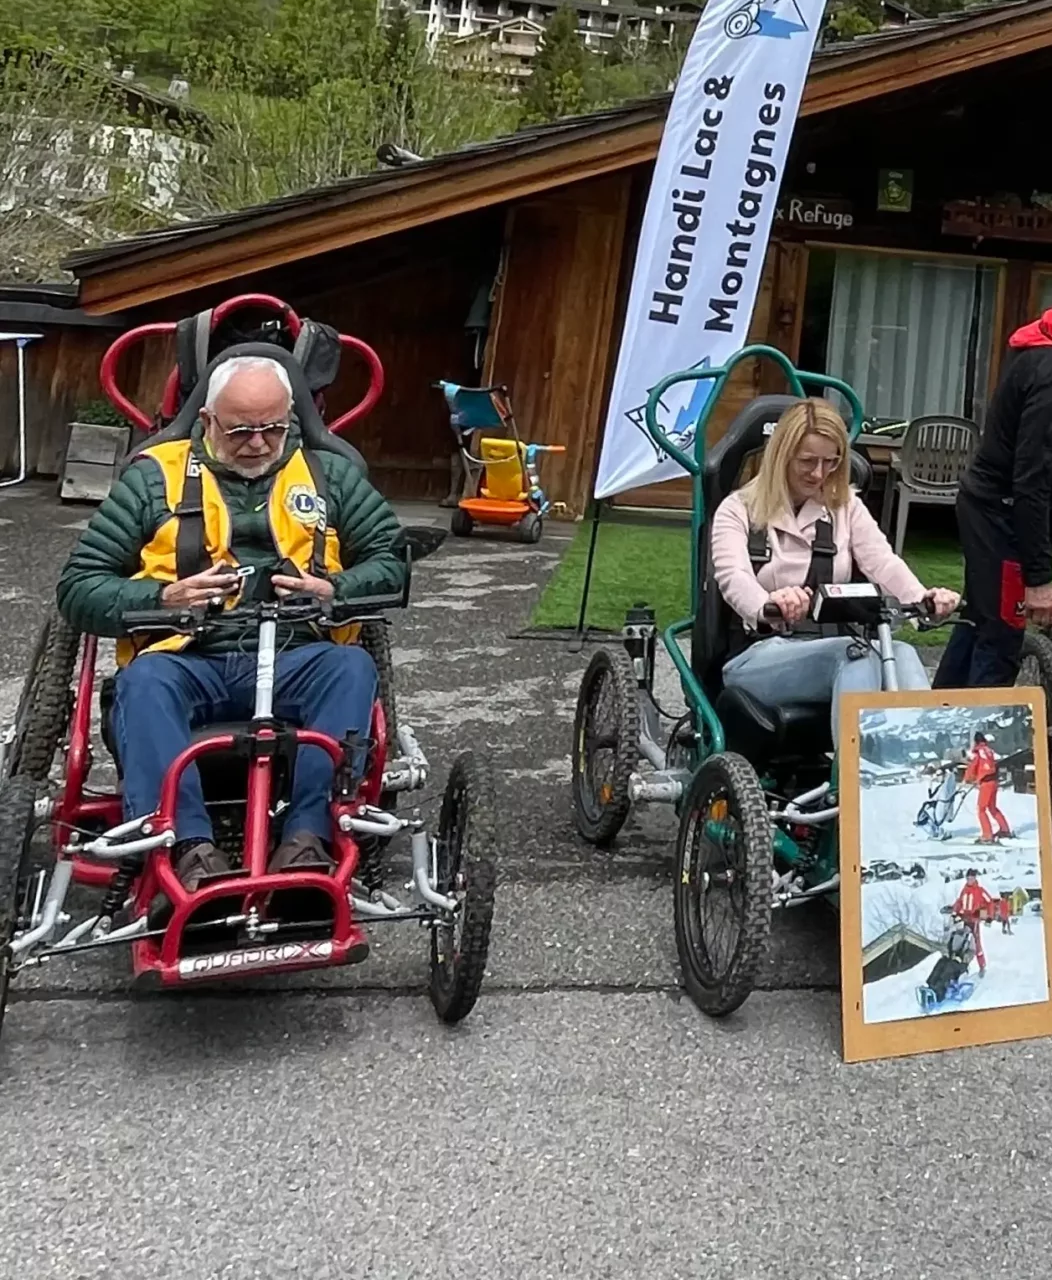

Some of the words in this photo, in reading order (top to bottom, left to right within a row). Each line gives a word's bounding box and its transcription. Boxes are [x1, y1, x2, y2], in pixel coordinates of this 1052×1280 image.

[648, 188, 706, 326] Handi
[680, 108, 724, 180] Lac
[703, 74, 736, 101] &
[704, 82, 786, 333] Montagnes
[789, 199, 853, 230] Refuge
[300, 496, 312, 511] L
